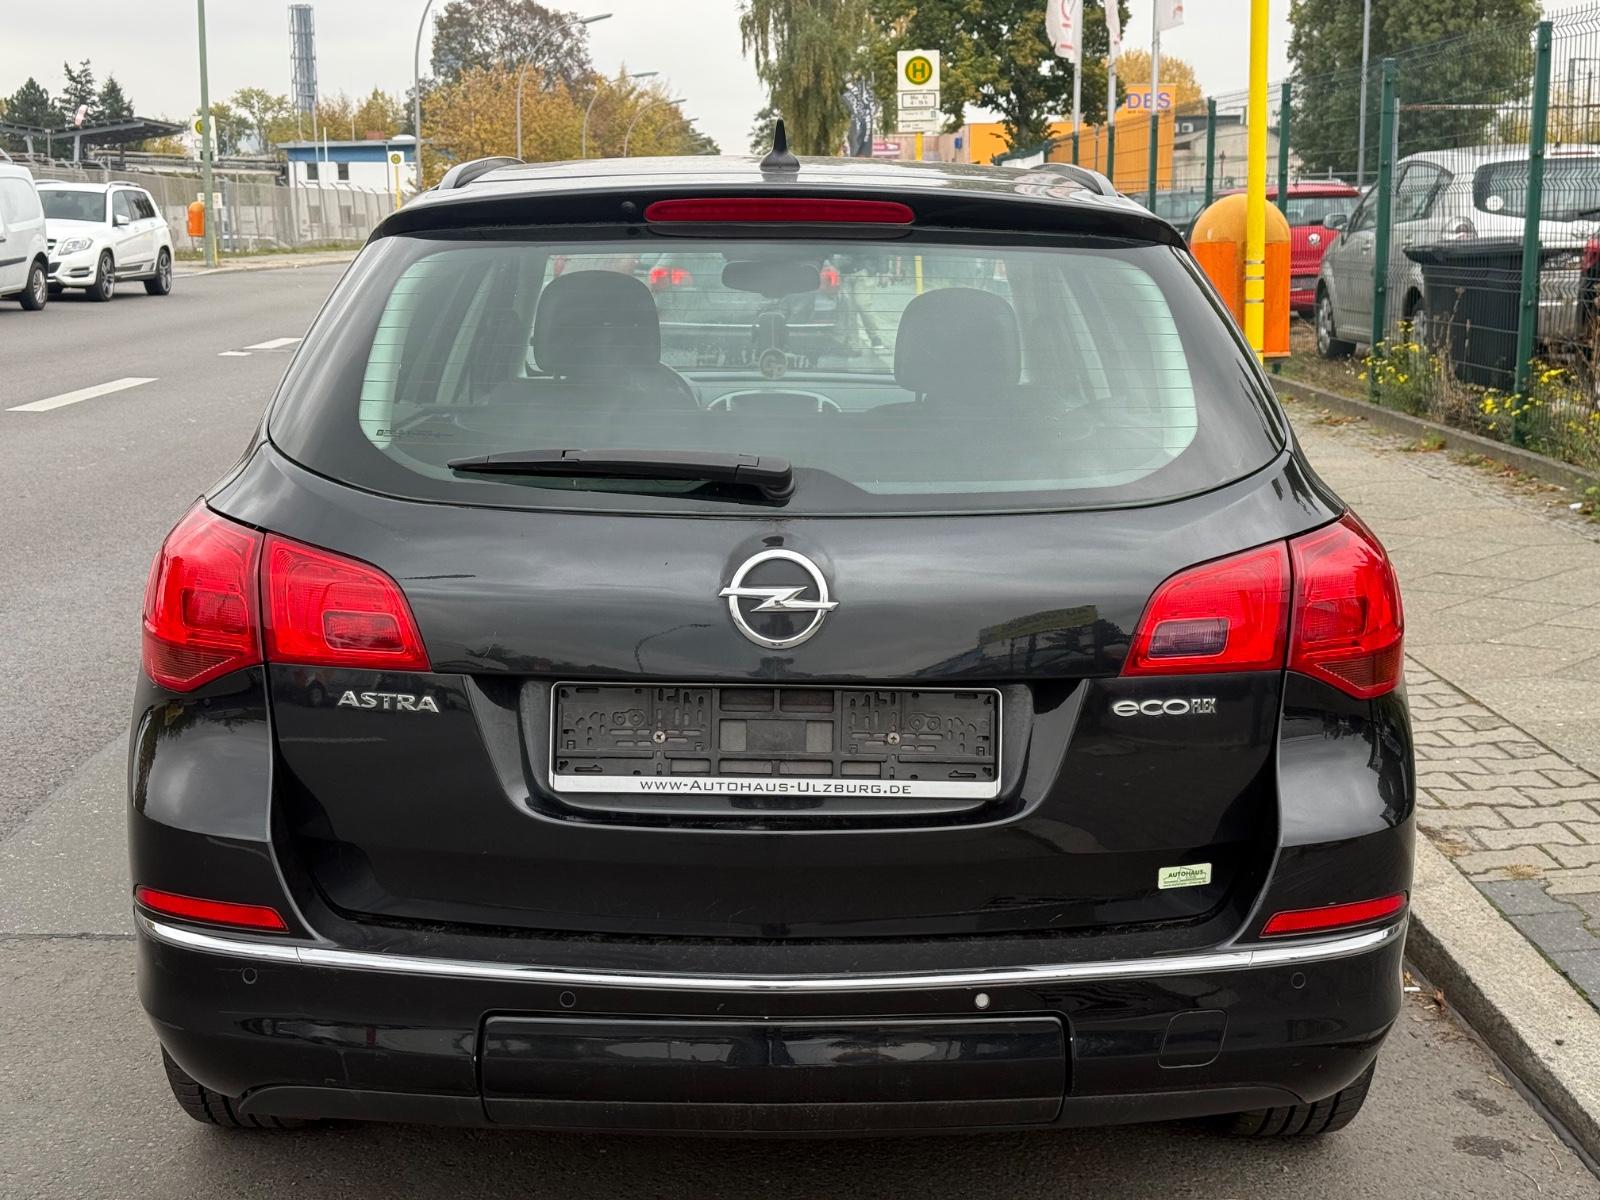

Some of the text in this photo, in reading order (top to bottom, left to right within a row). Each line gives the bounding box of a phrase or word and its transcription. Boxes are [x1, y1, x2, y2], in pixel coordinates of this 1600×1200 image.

[912, 62, 925, 78] H
[337, 690, 440, 713] ASTRA
[1168, 869, 1204, 878] AUTOHAUS
